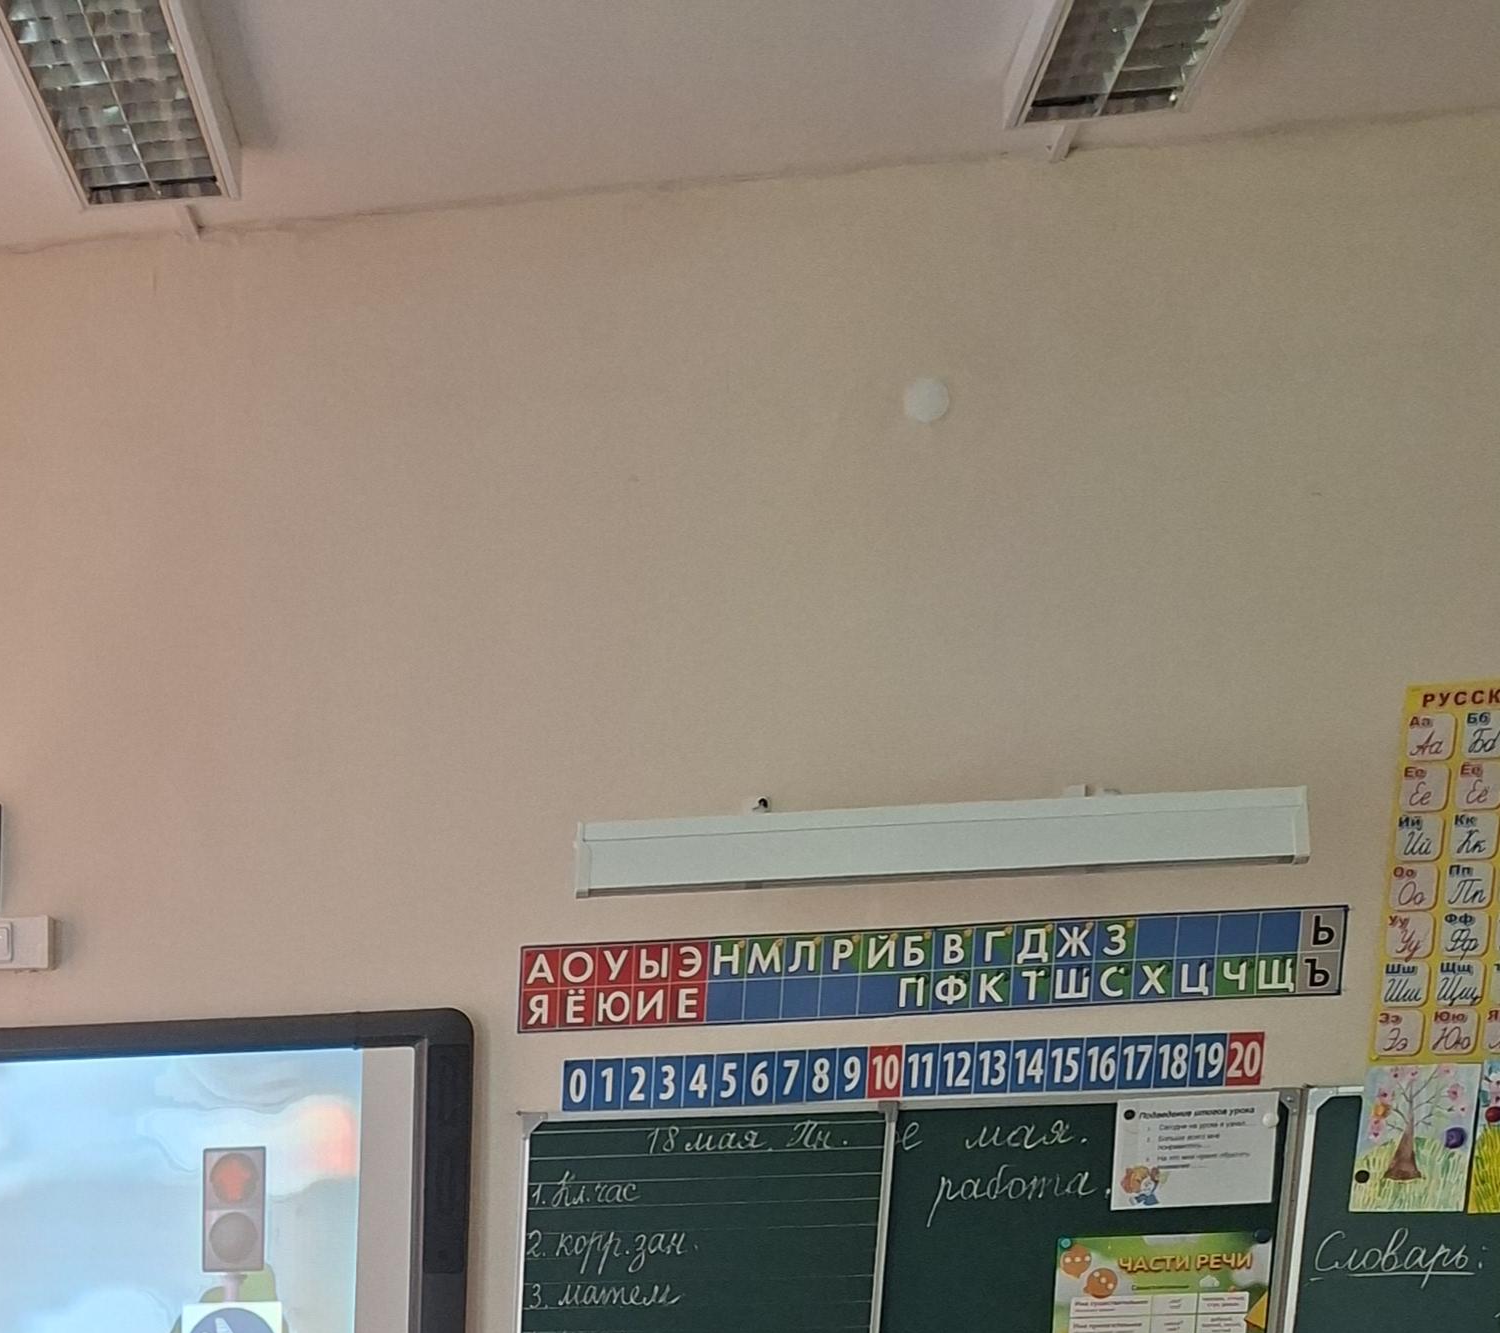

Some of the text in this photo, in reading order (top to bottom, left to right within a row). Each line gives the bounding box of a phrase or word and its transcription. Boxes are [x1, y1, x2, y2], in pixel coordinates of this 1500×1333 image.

[526, 954, 555, 984] А
[562, 951, 594, 983] О
[602, 949, 628, 981] У
[639, 948, 668, 979] Ы
[677, 946, 702, 977] Э
[713, 945, 740, 975] Н
[747, 943, 781, 974] М
[788, 940, 815, 972] Л
[832, 939, 854, 970] Р
[903, 936, 925, 967] Б
[943, 934, 964, 964] В
[985, 931, 1006, 962] Г
[1017, 928, 1049, 963] Д
[1056, 926, 1092, 958] Ж
[1103, 924, 1127, 956] З
[1312, 915, 1335, 947] Ь
[527, 958, 1330, 1025] Я Ё Ю И Е П Ф К Т Ш С Х Ц Ч Щ Ъ
[569, 1041, 1260, 1102] 0 1 2 3 4 5 6 7 8 9 10 11 12 13 14 15 16 17 18 19 20
[646, 1126, 680, 1154] 18
[527, 1230, 546, 1257] 2.
[1118, 1252, 1253, 1272] ЧАСТИ РЕЧИ
[529, 1283, 548, 1309] 3.
